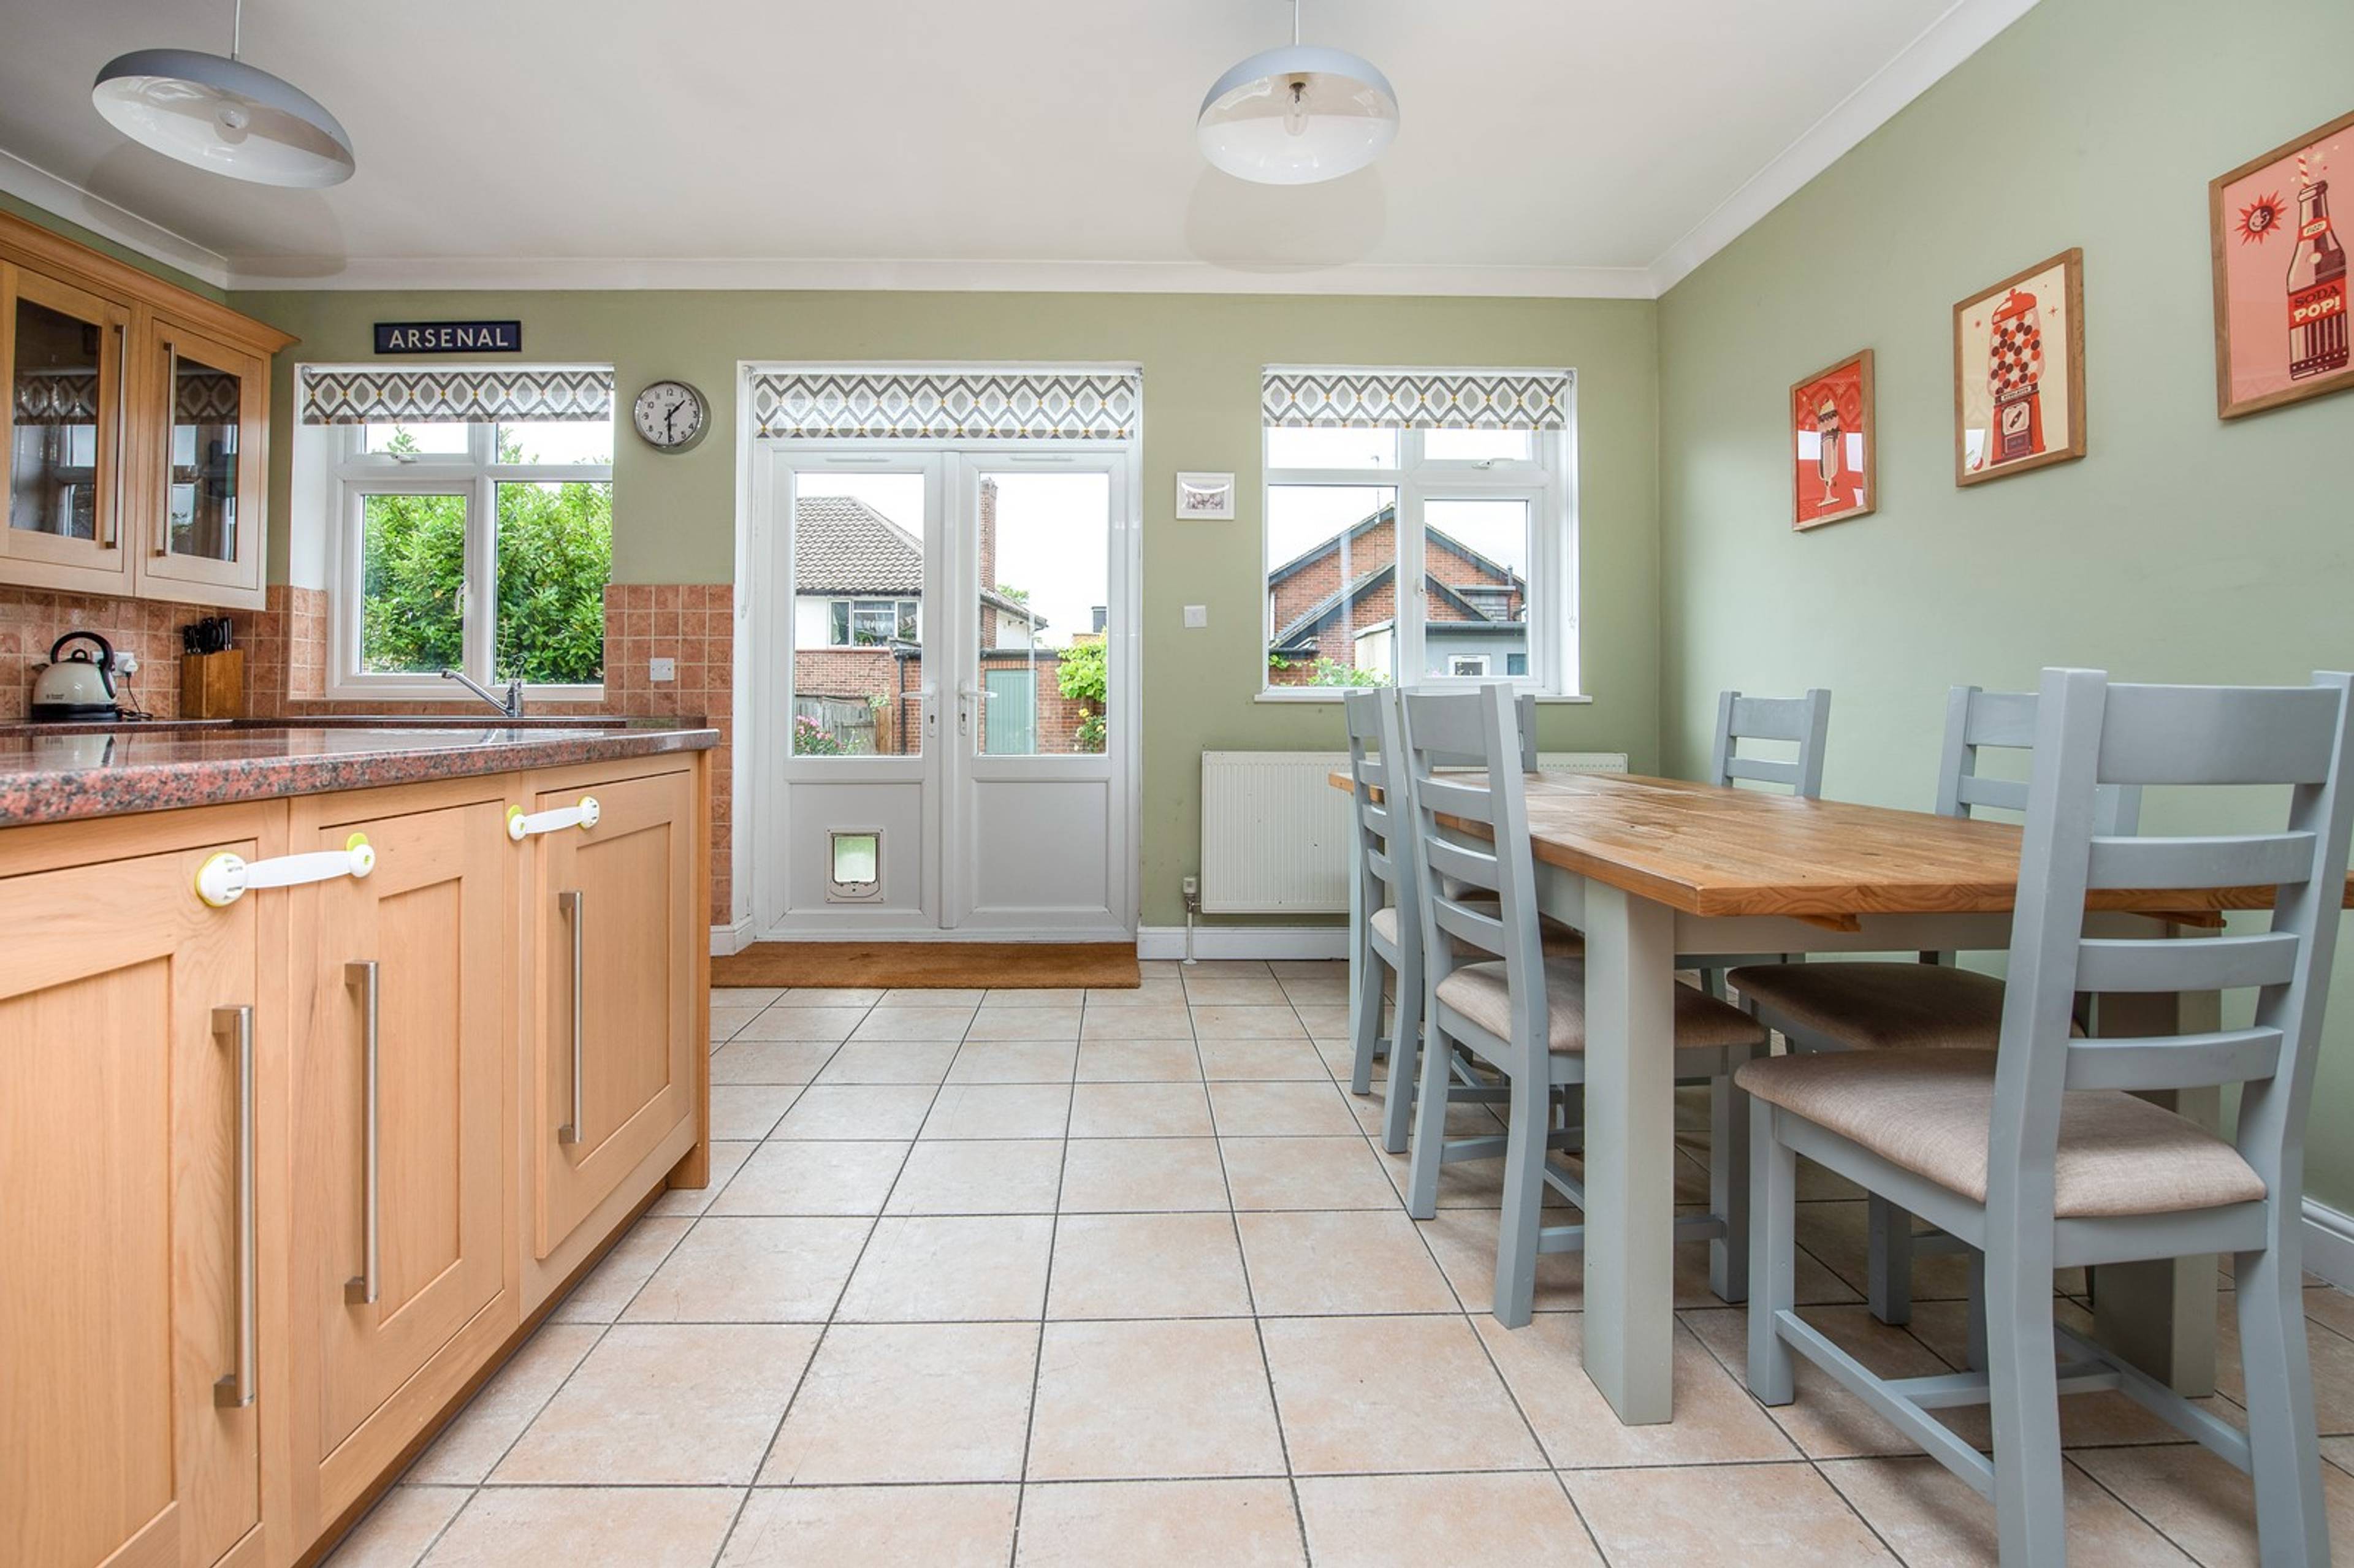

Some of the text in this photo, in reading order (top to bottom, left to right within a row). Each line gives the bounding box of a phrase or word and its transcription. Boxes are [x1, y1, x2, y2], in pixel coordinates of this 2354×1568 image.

[2295, 286, 2341, 308] SODA
[2293, 295, 2341, 322] POP!
[389, 328, 509, 348] ARSENAL
